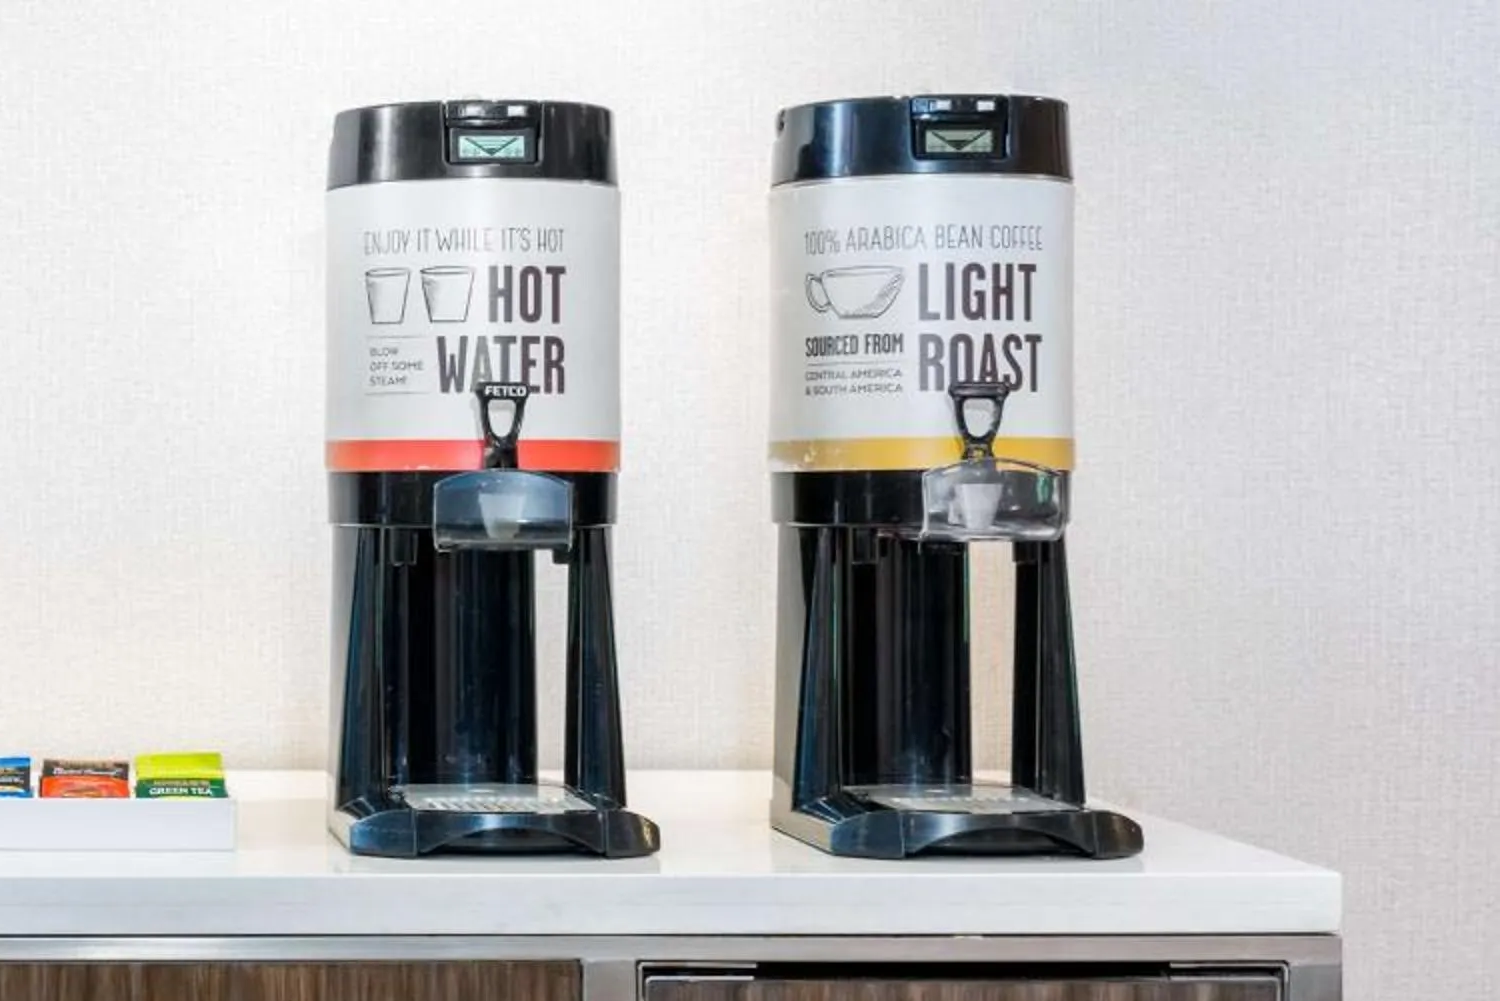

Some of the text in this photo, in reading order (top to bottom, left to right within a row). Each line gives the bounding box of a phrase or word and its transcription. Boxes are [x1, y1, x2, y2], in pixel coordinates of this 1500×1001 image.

[364, 227, 564, 256] ENJOY IT WHILE IT'S HOT
[846, 226, 925, 251] ARABICA
[935, 224, 983, 250] BEAN
[991, 225, 1043, 251] COFFEE
[488, 265, 566, 324] HOT
[918, 263, 1037, 322] LIGHT
[805, 333, 904, 358] SOURCED FROM
[437, 336, 565, 394] WATER
[918, 333, 1043, 393] ROAST
[485, 385, 527, 397] FETCO
[149, 787, 213, 796] GREEN TEA
